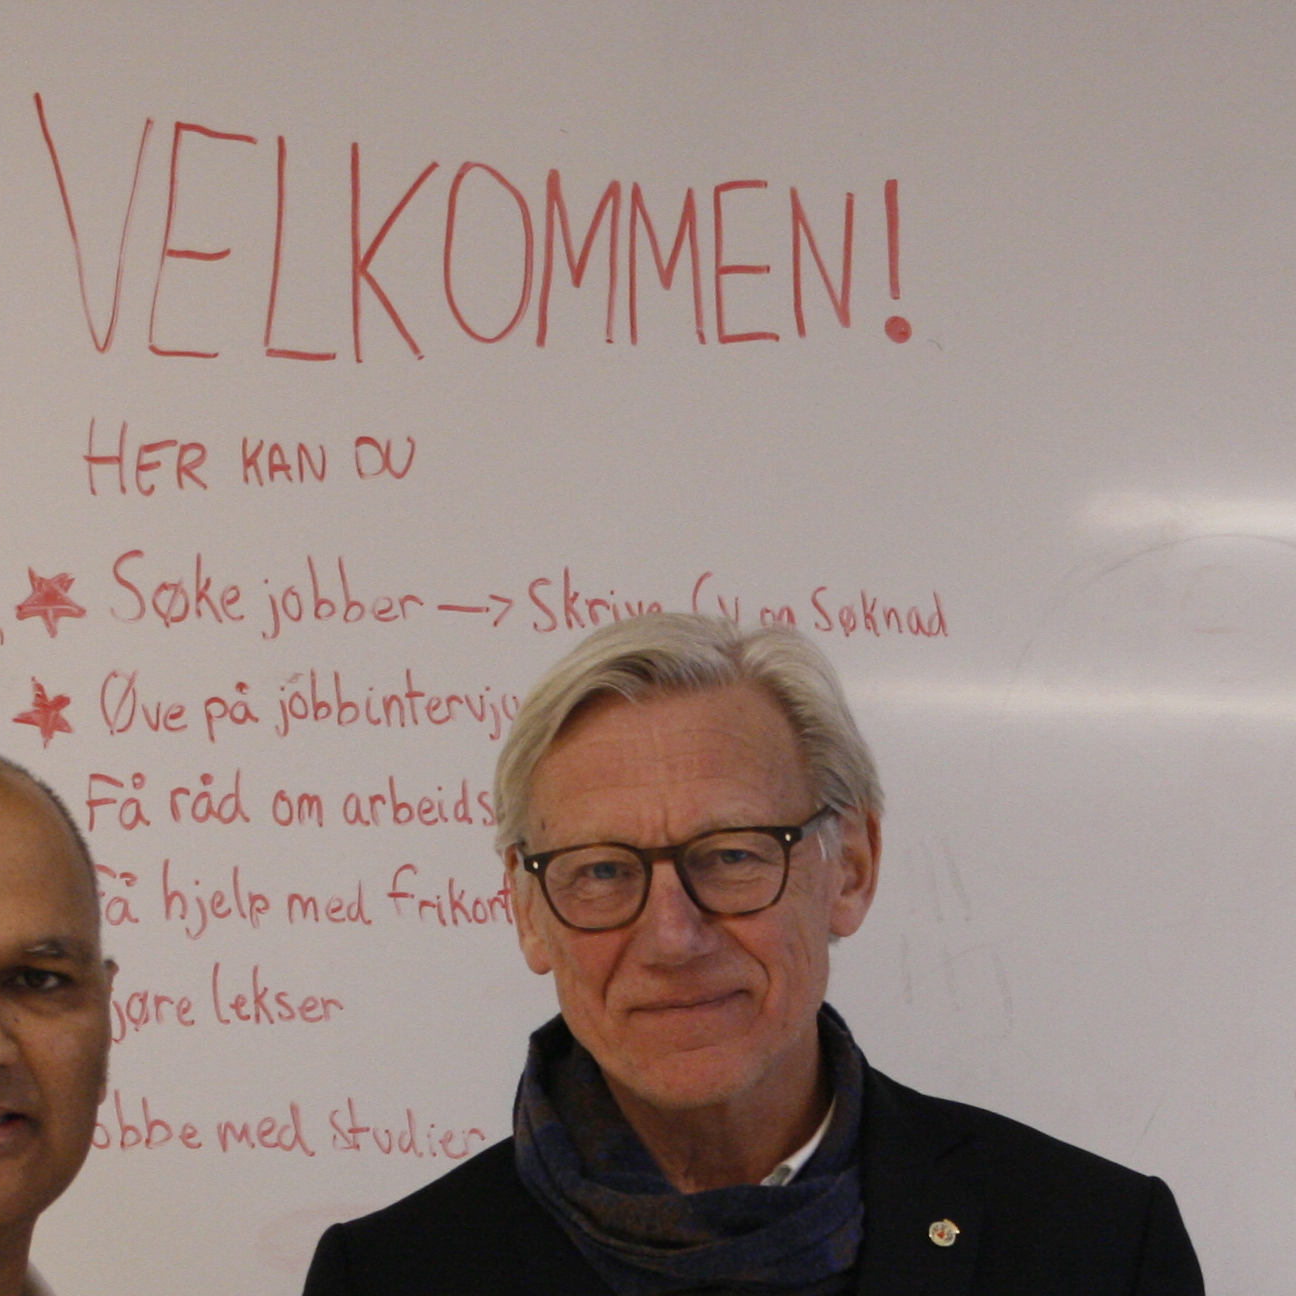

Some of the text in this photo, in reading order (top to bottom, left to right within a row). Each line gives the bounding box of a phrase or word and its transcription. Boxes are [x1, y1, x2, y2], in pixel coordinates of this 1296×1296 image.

[33, 91, 915, 364] VELKOMMEN!
[84, 416, 416, 497] HER KAN DU
[109, 549, 246, 628] Søke
[261, 555, 425, 640] jobber
[100, 669, 188, 735] Øve
[204, 680, 260, 743] på
[85, 772, 151, 831] Få
[170, 769, 251, 825] råd
[270, 789, 324, 828] om
[163, 858, 271, 940] hjelp
[287, 883, 373, 926] med
[110, 961, 344, 1043] jøre lekser
[90, 1089, 203, 1151] obbe
[216, 1101, 316, 1157] med
